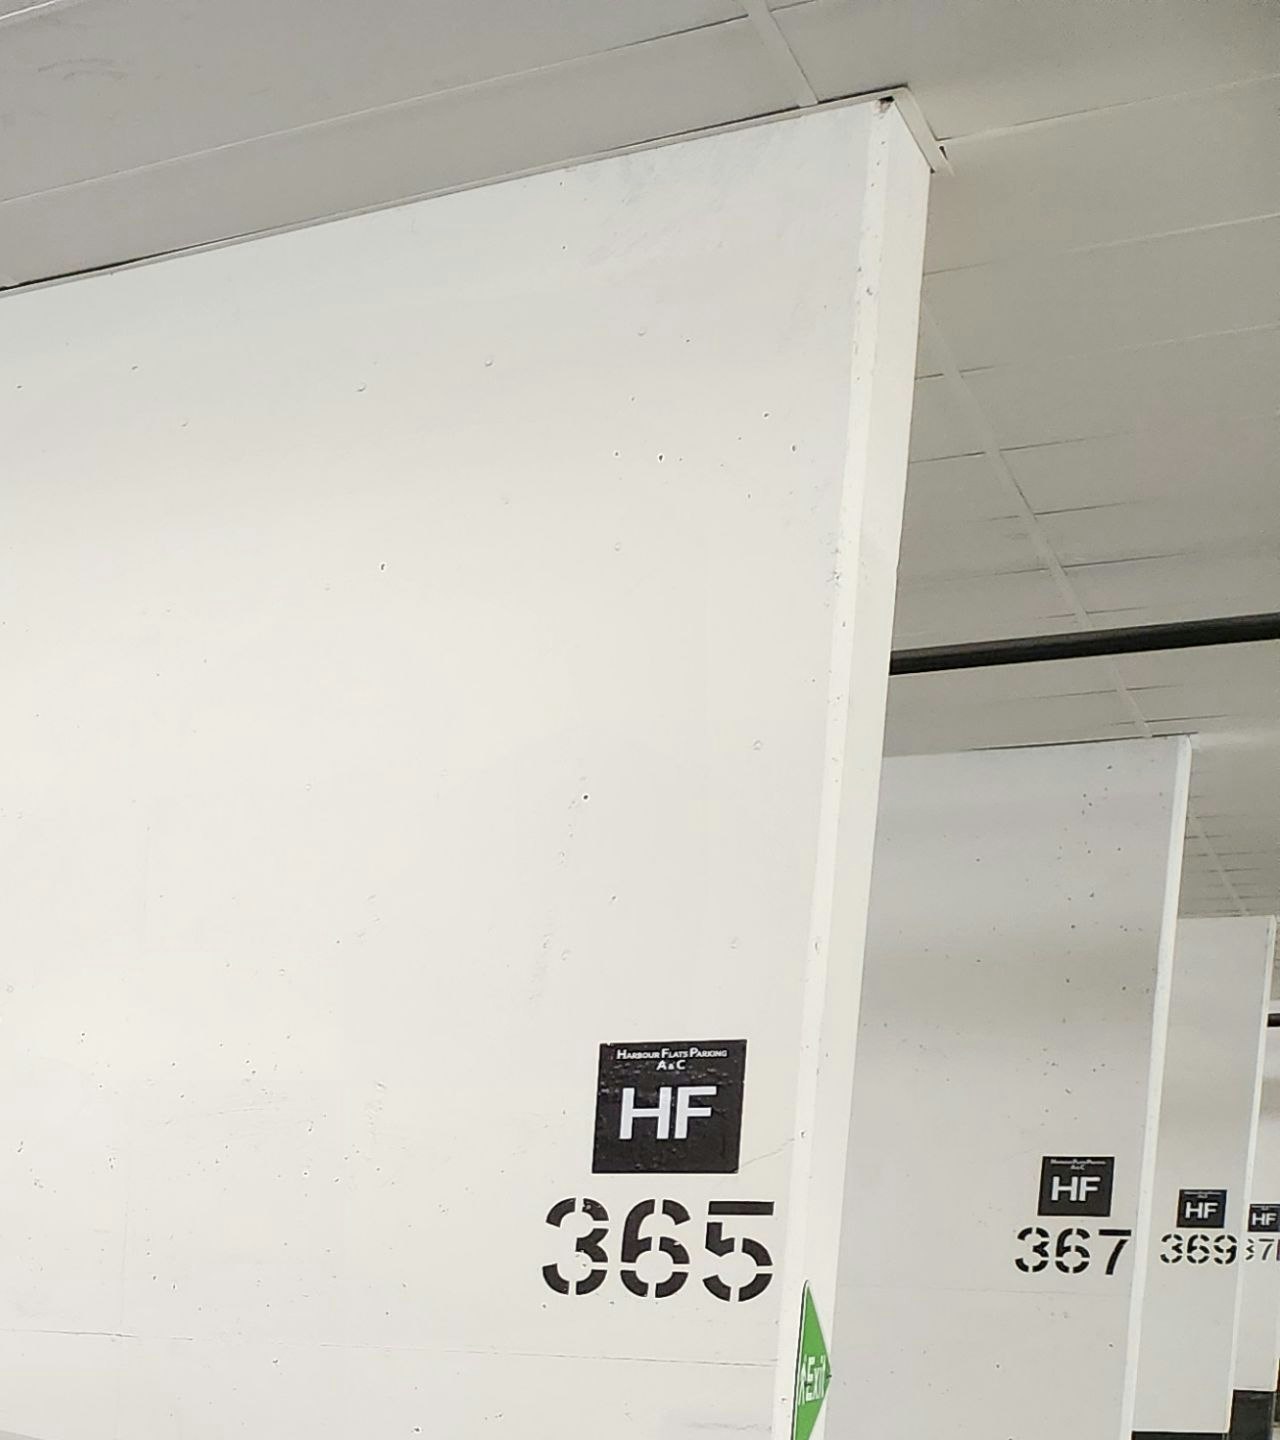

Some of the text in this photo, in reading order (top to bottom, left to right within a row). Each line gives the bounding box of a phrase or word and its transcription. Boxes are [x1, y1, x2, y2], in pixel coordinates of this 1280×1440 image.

[618, 1085, 718, 1140] HF
[1050, 1176, 1101, 1201] HF
[1185, 1201, 1218, 1219] HF
[1252, 1212, 1277, 1226] HF
[542, 1197, 775, 1302] 365
[1014, 1227, 1132, 1276] 367
[1160, 1233, 1238, 1264] 369
